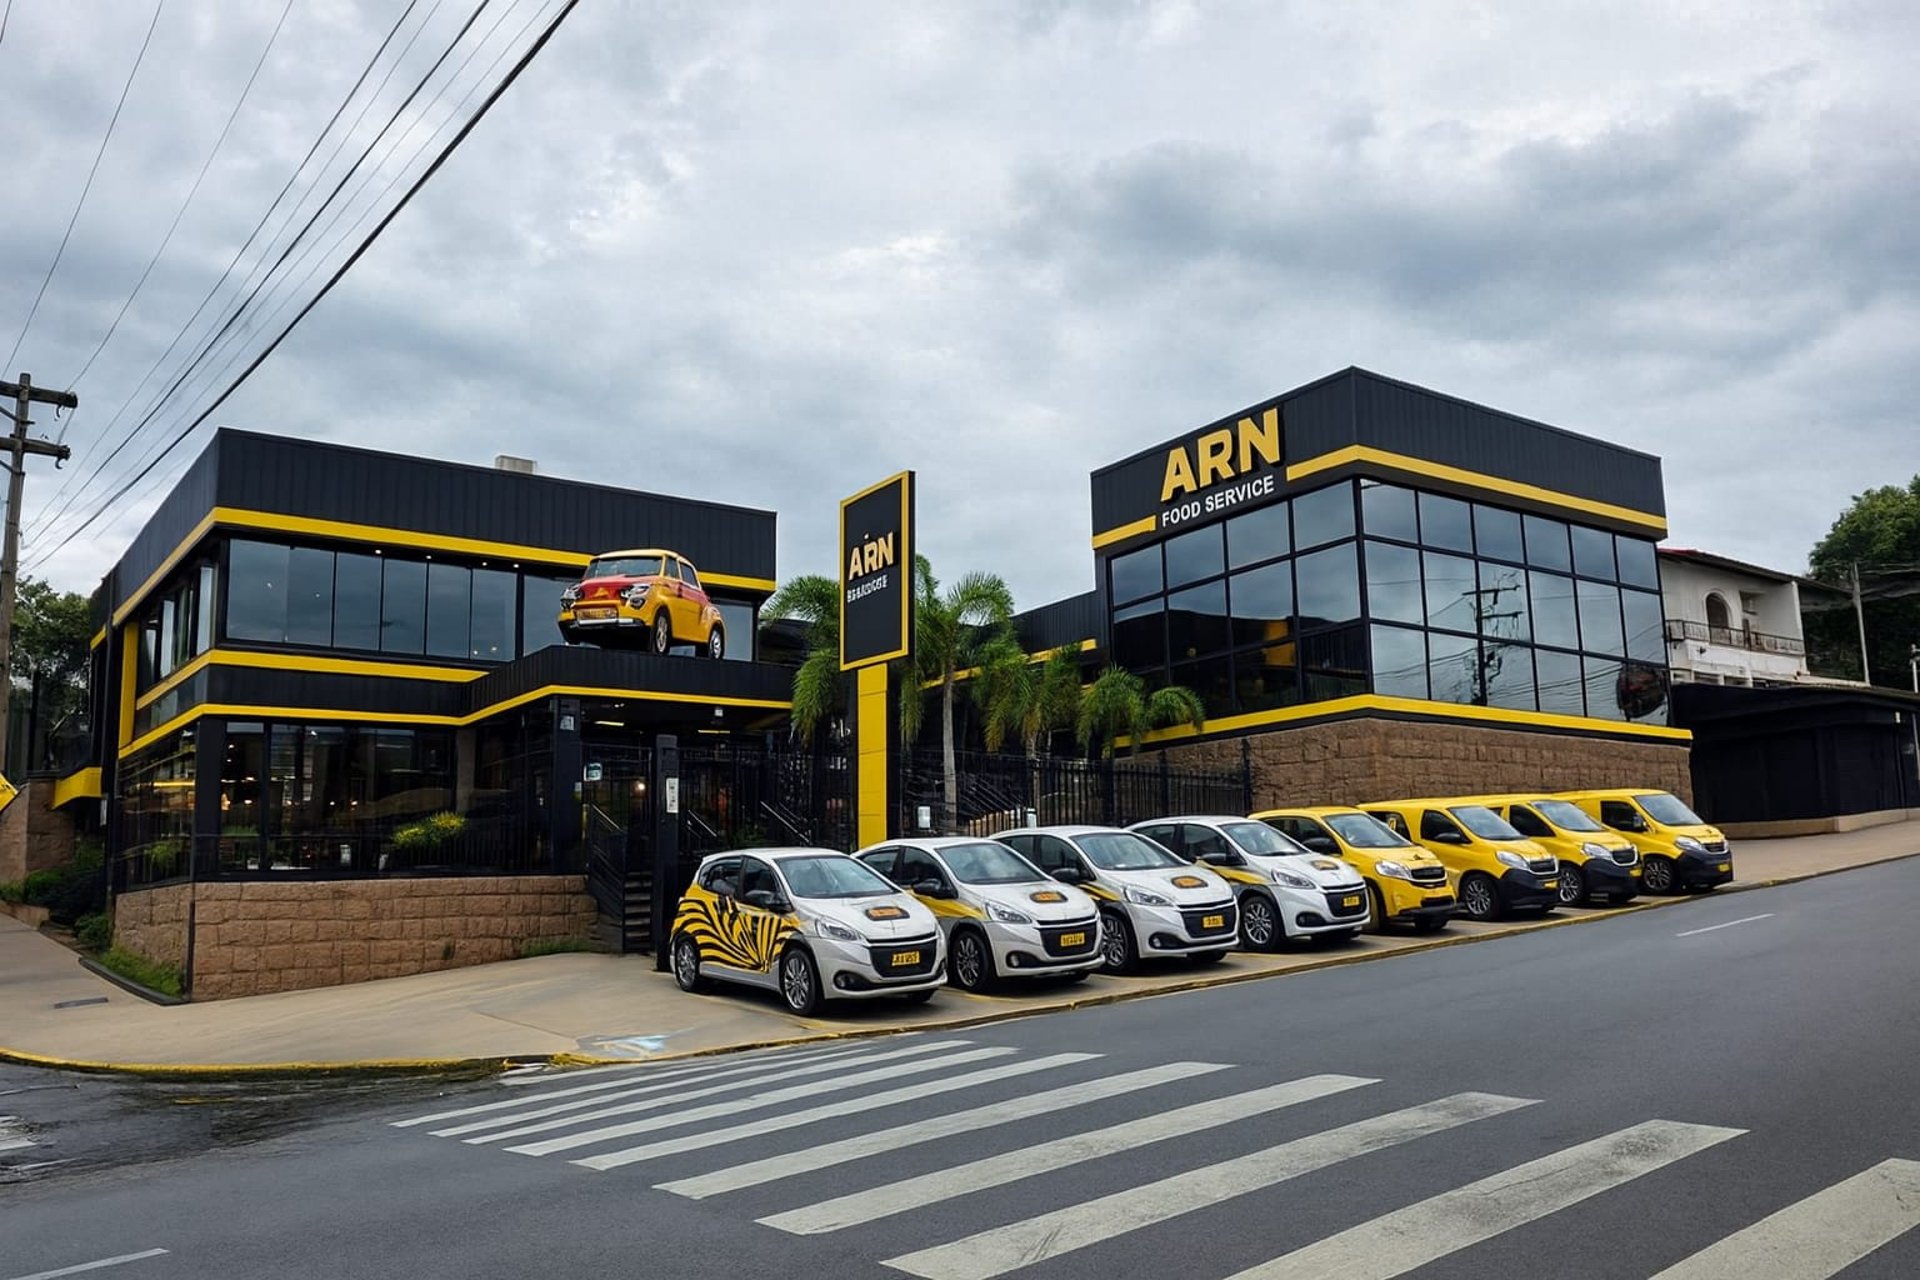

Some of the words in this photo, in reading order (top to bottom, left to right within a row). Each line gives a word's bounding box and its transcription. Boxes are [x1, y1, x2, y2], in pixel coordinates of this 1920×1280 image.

[1160, 407, 1280, 502] ARN
[1161, 501, 1201, 527] FOOD
[1205, 475, 1275, 512] SERVICE
